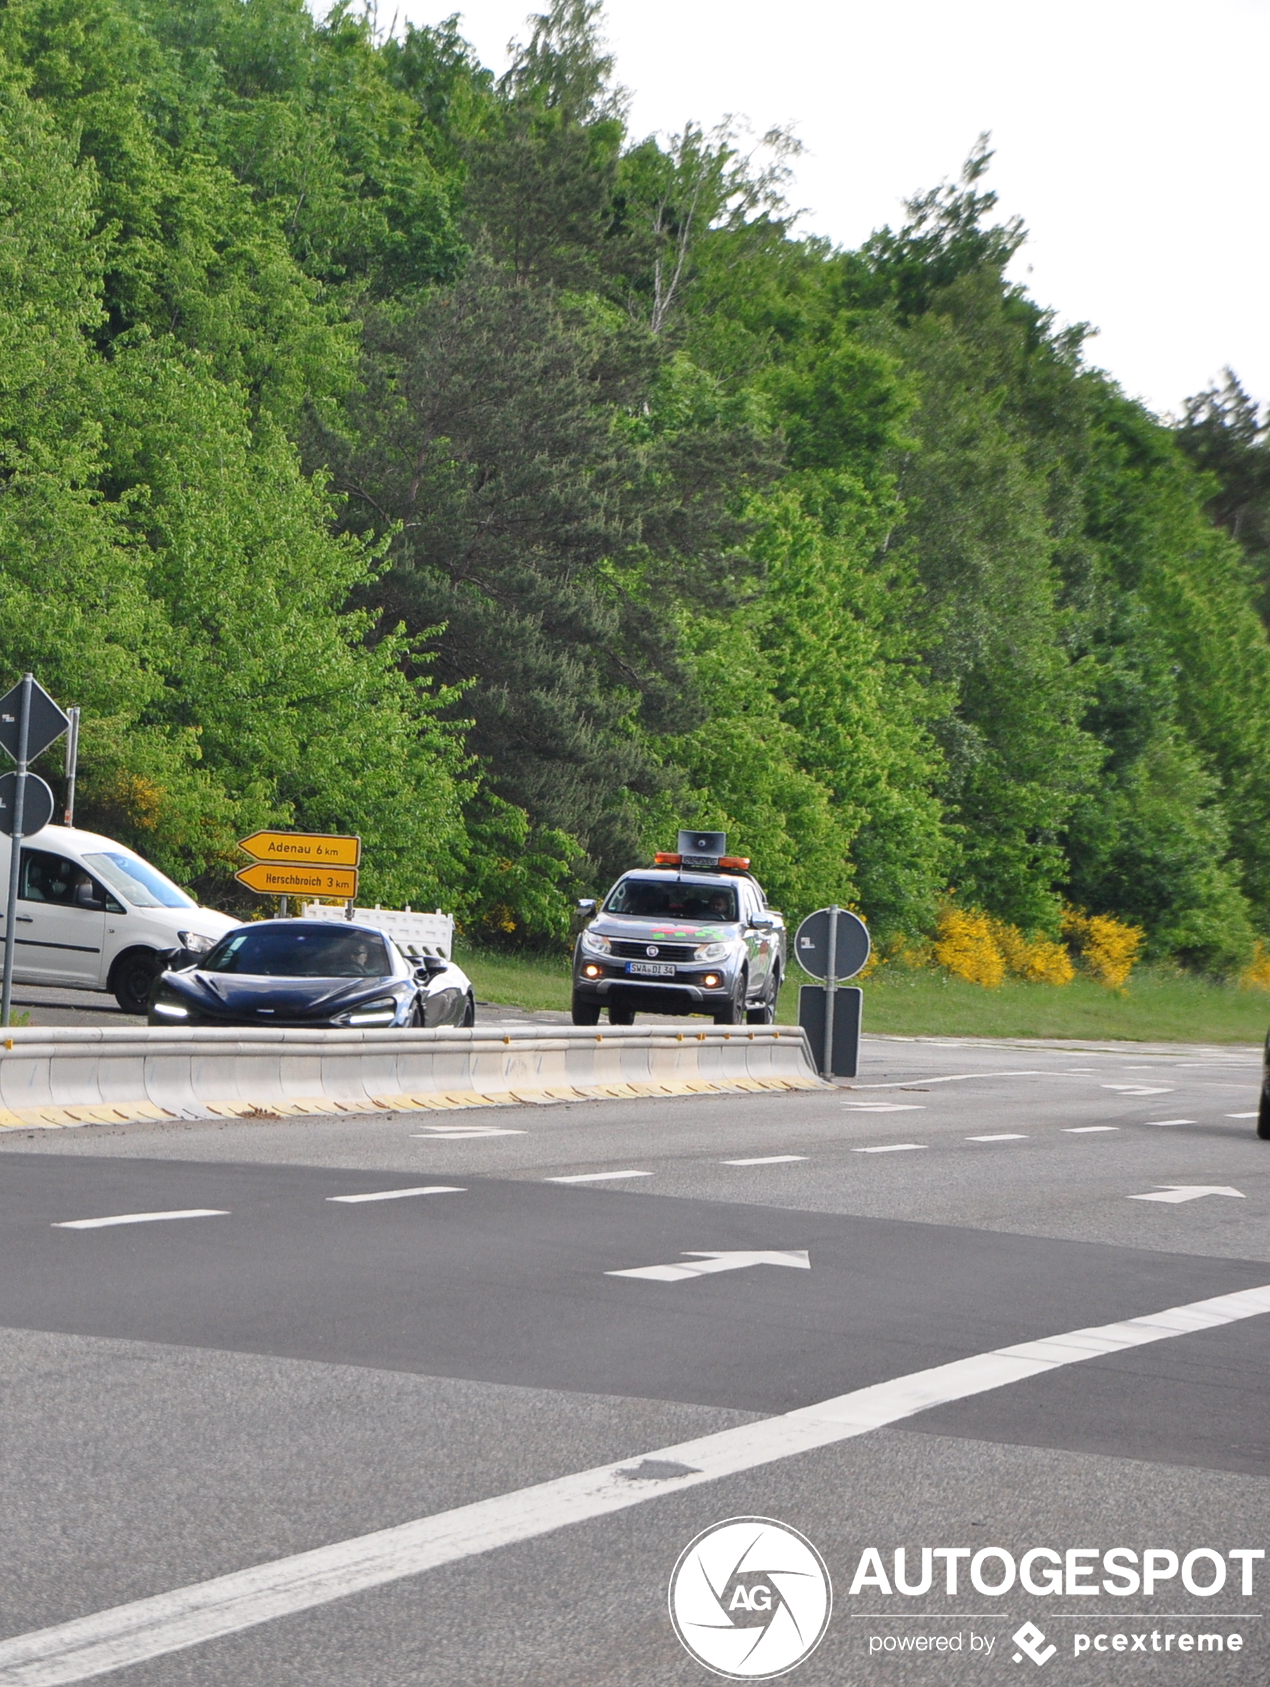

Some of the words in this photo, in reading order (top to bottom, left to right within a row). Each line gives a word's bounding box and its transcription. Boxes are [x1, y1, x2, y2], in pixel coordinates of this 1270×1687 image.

[268, 842, 311, 854] Adenau
[316, 845, 323, 855] 6
[325, 848, 338, 856] km
[266, 873, 322, 887] Herschbroich
[327, 877, 334, 887] 3
[336, 880, 350, 888] km
